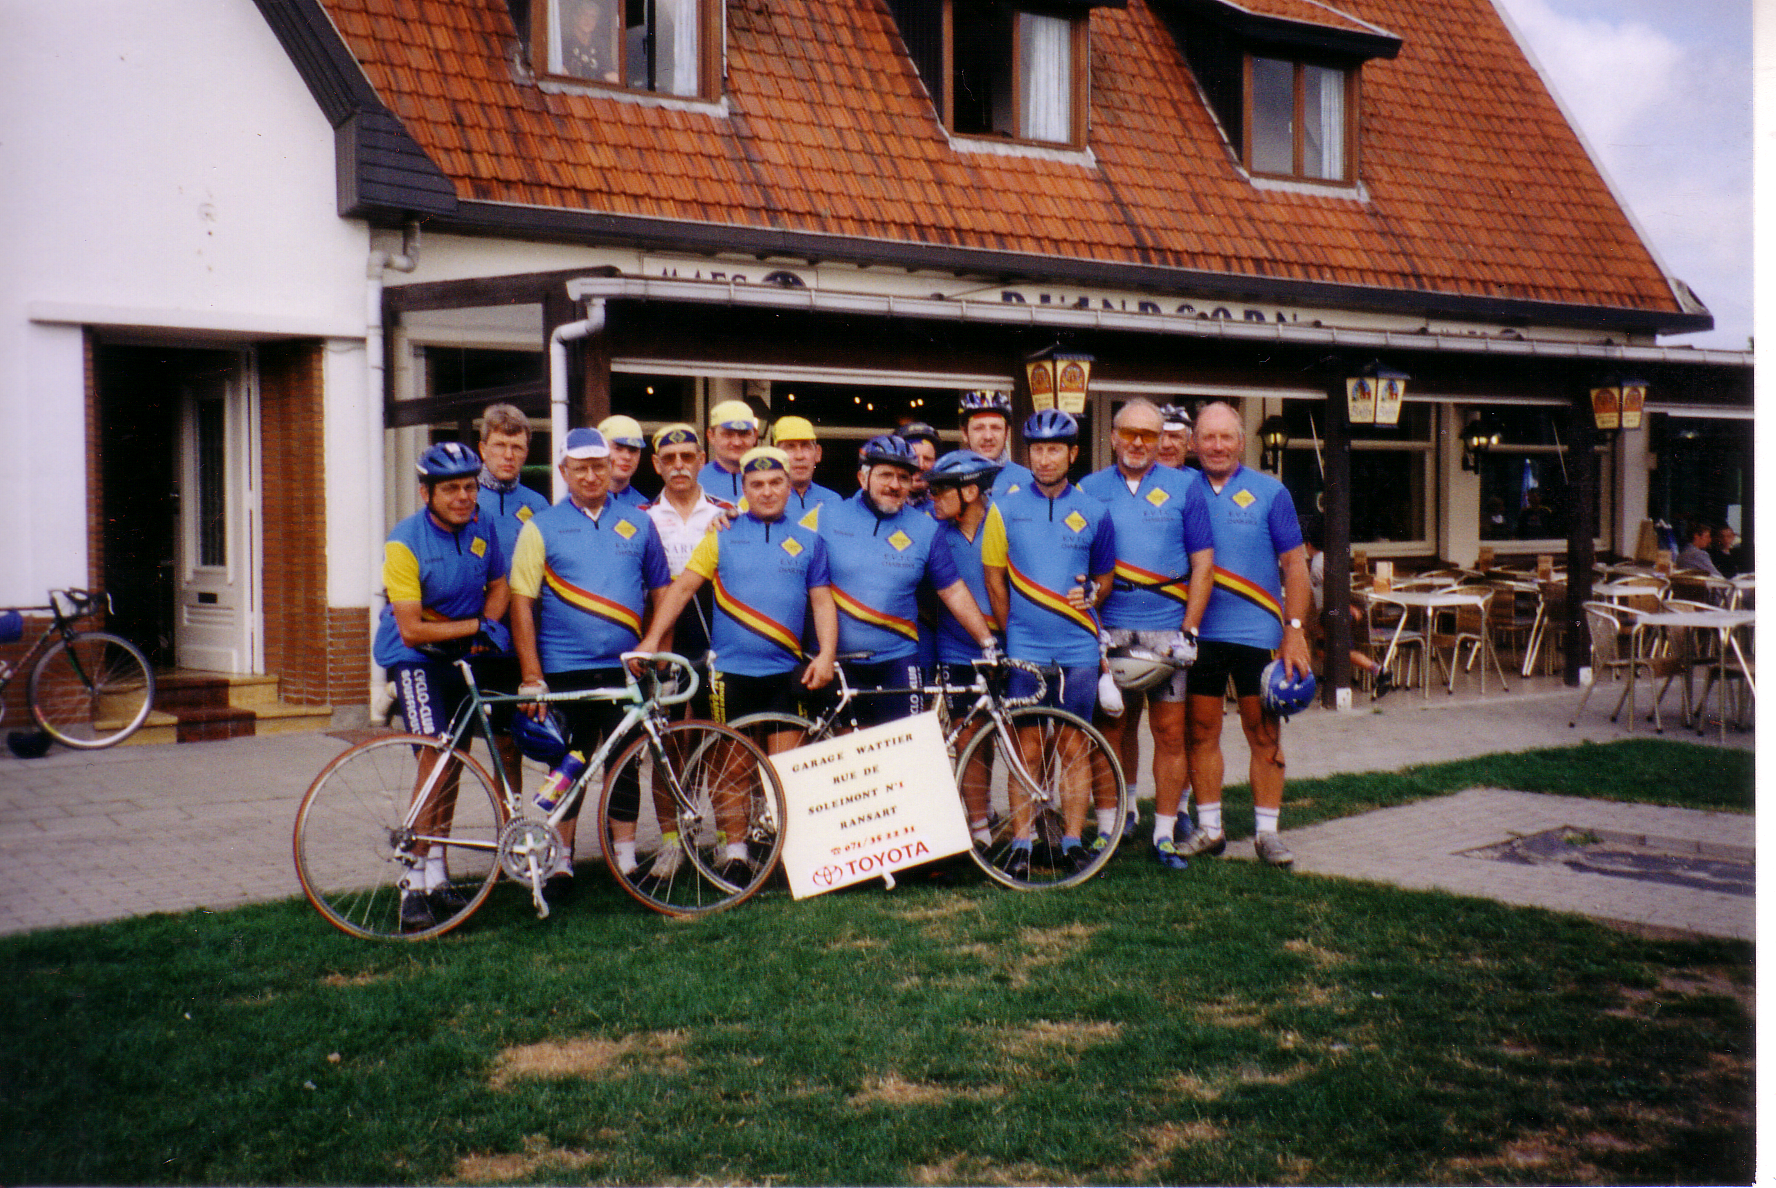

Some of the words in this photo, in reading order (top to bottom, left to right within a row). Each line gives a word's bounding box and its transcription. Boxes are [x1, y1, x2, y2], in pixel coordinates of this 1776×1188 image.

[792, 751, 844, 773] GARAGE
[856, 733, 913, 755] WATTIER
[833, 771, 857, 784] RUE
[863, 764, 880, 776] DE
[808, 787, 878, 815] SOLEIMONT
[840, 805, 897, 830] RANSART
[845, 841, 930, 875] TOYOTA
